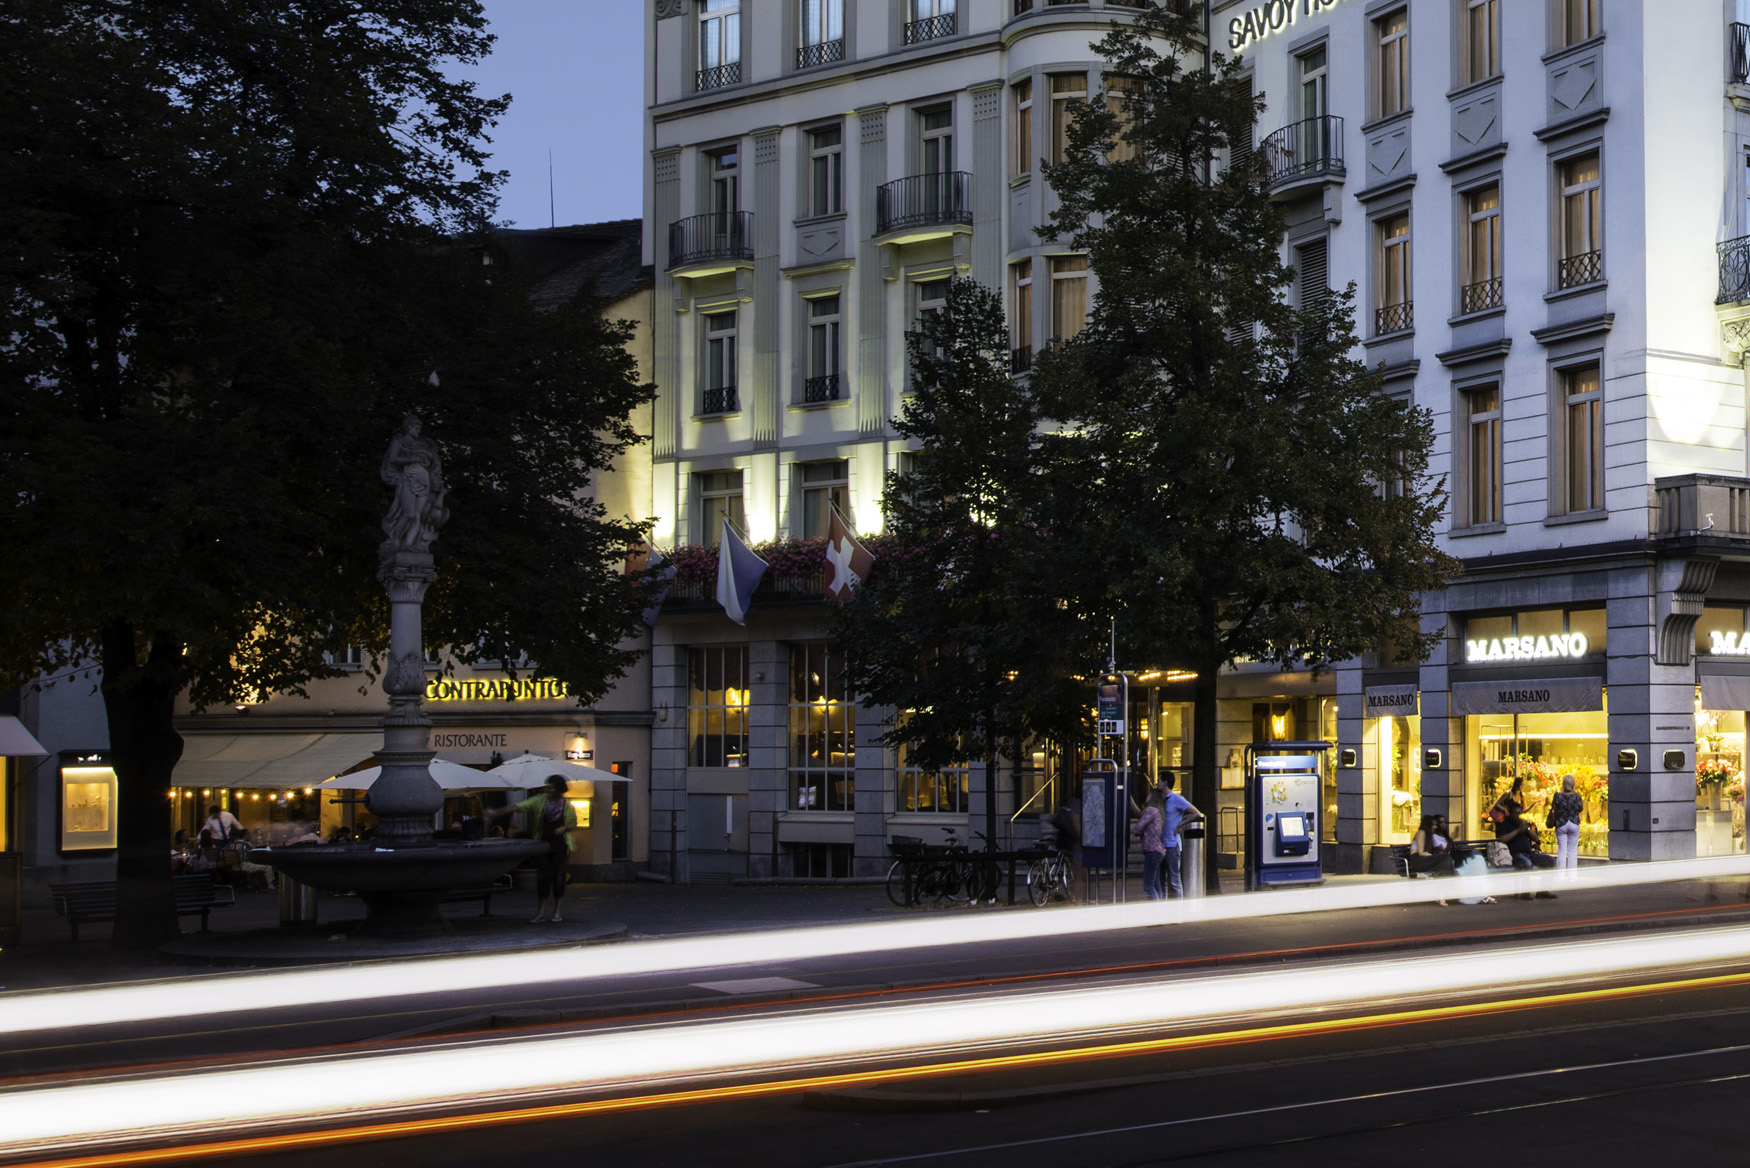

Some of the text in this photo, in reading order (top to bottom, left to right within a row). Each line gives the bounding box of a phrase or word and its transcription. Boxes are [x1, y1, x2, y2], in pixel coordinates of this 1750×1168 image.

[1467, 632, 1588, 661] MARSANO
[424, 680, 567, 699] CONTRAPUNTO
[1498, 689, 1550, 704] MARSANO
[1368, 693, 1414, 708] MARSANO
[434, 734, 507, 747] RISTORANTE
